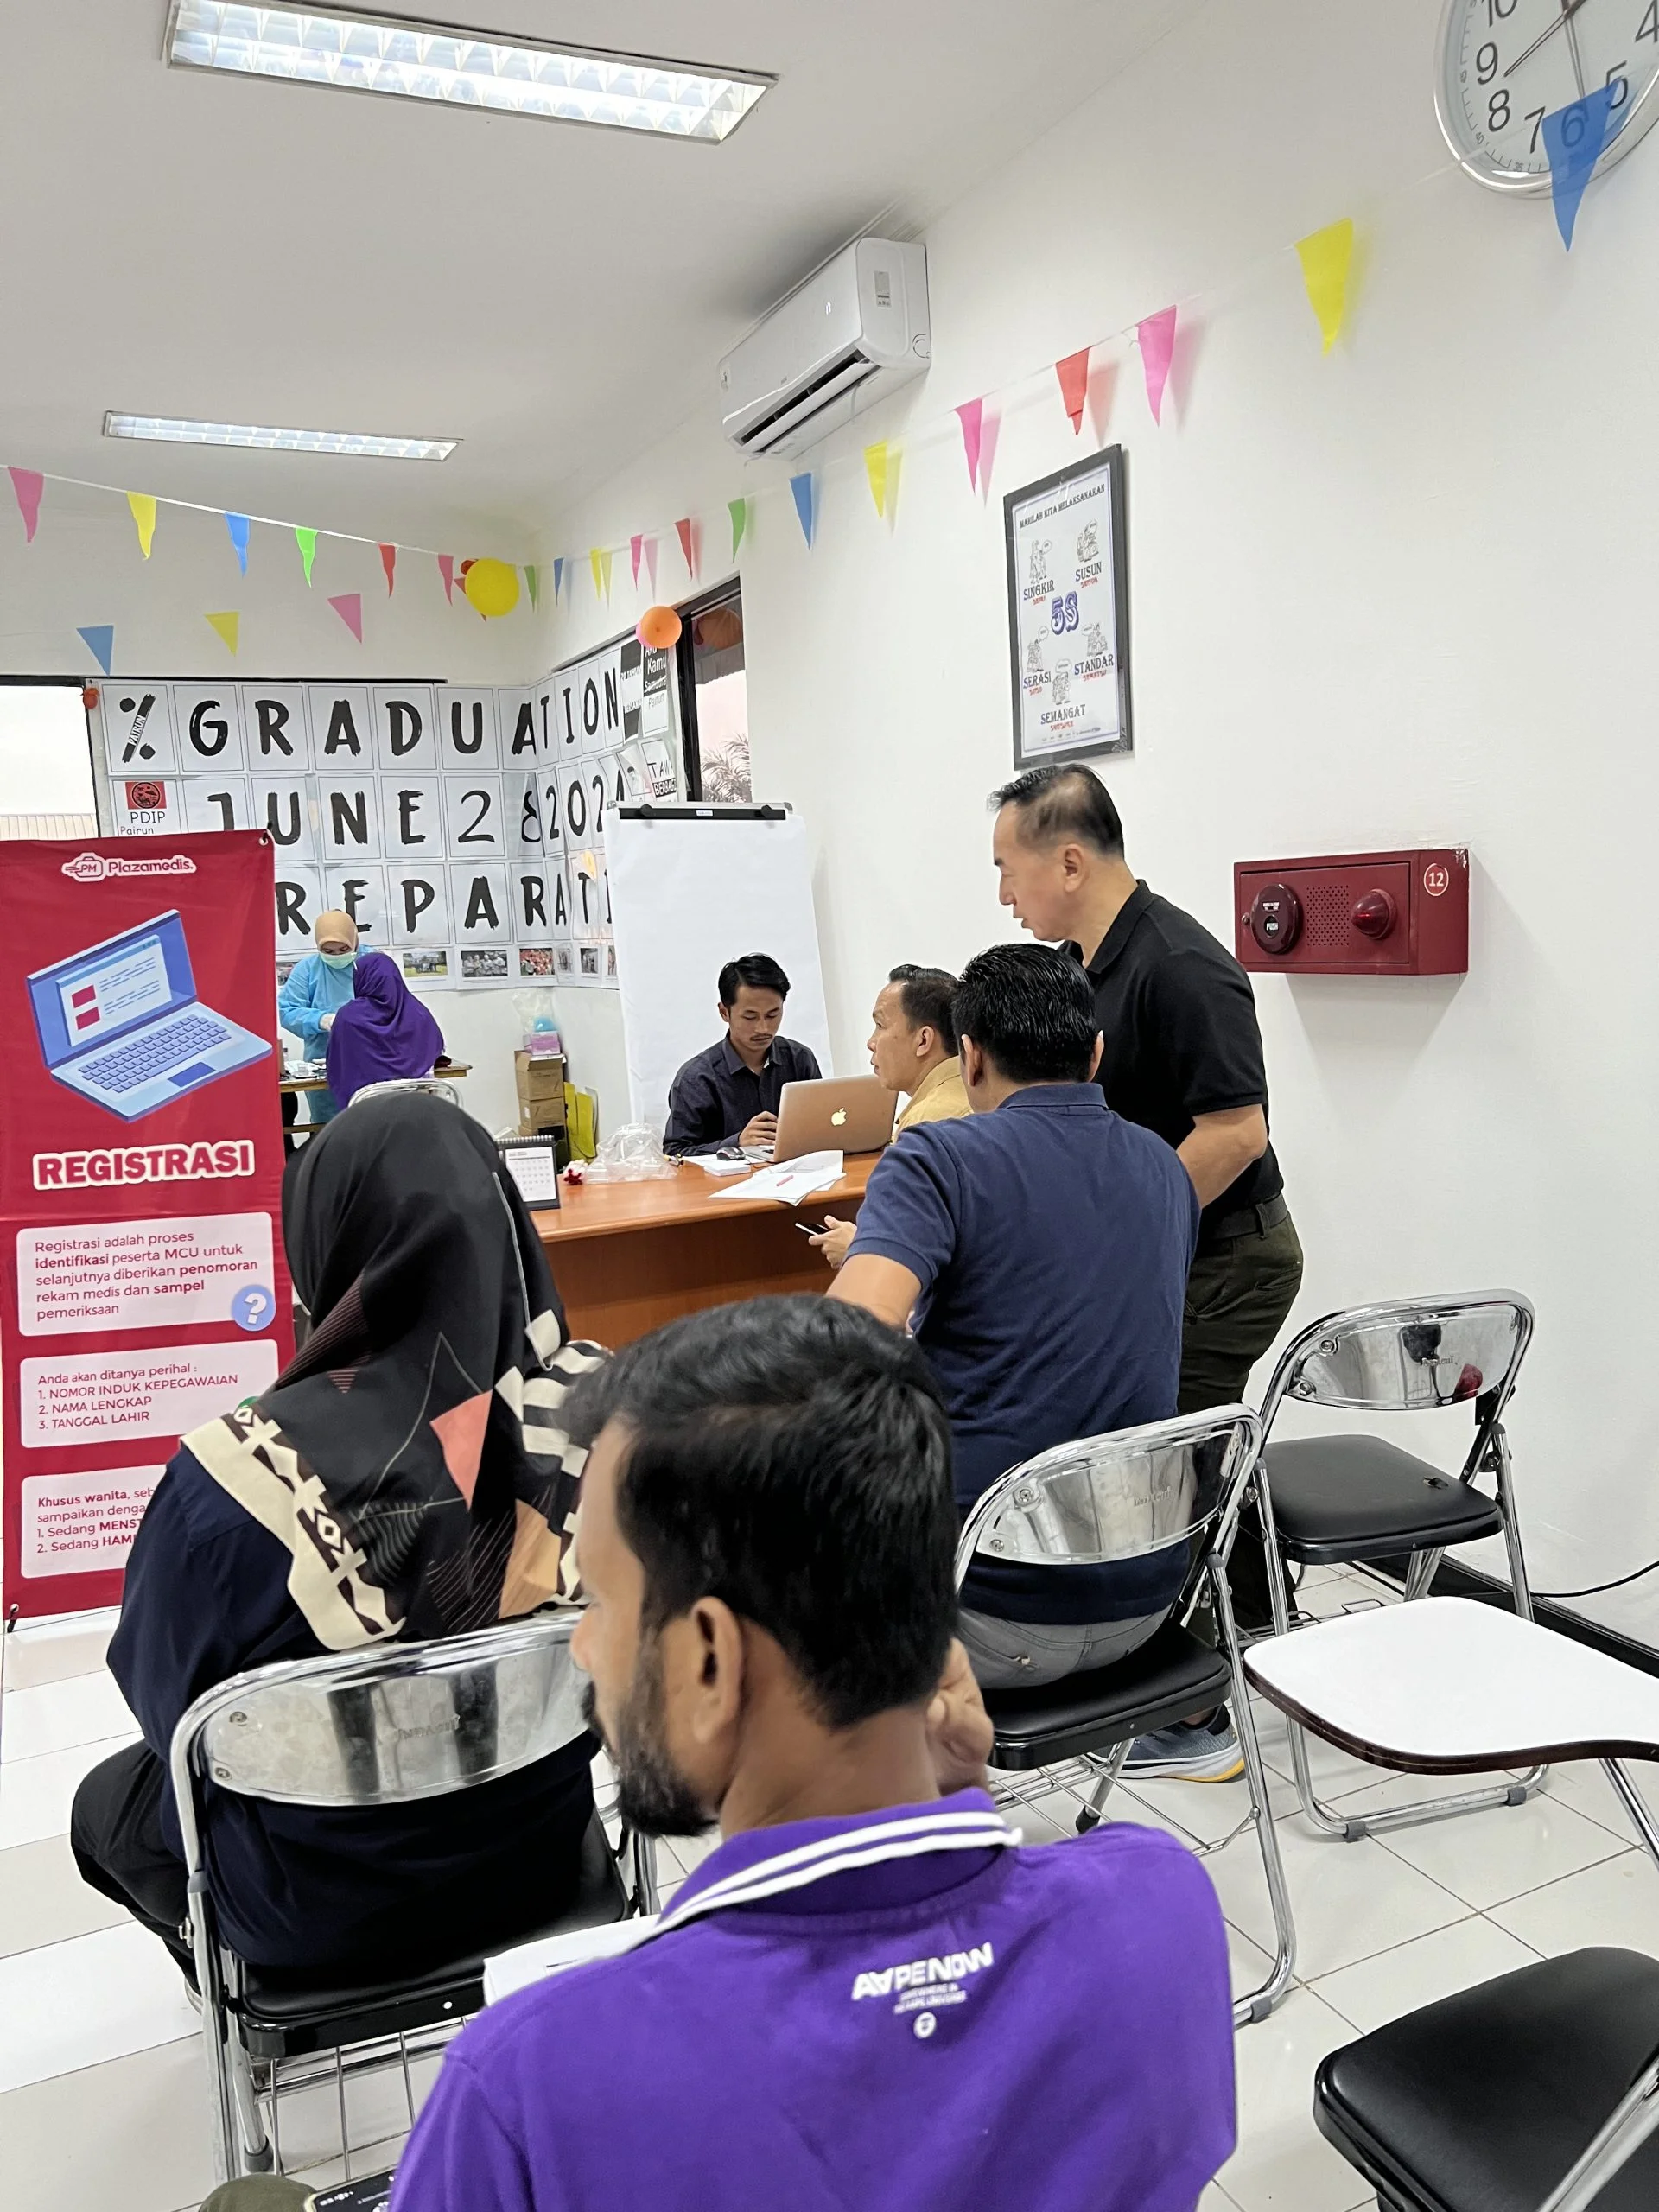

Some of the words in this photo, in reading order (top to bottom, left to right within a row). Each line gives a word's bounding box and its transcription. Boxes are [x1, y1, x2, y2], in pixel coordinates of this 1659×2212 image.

[1476, 41, 1498, 85] 9
[1605, 60, 1629, 110] 5
[1488, 89, 1510, 132] 8
[1524, 106, 1546, 154] 7
[1560, 102, 1589, 148] 6
[1044, 505, 1058, 518] KITA
[1058, 484, 1105, 512] MELAKSANAKAN
[1075, 562, 1103, 582] SUSUN
[1023, 580, 1055, 601] SINGKIR
[1051, 591, 1079, 635] 5S
[1074, 654, 1114, 676] STANDAR
[1023, 671, 1052, 690] SERASI
[189, 667, 620, 756] GRADUATION
[1040, 704, 1086, 725] SEMANGAT
[128, 715, 146, 746] PAIRUN
[130, 810, 166, 824] PDIP
[207, 790, 426, 845] JUNE
[458, 790, 542, 843] 28
[120, 825, 154, 836] Pairun
[81, 863, 97, 873] PM
[1428, 872, 1444, 887] 12
[38, 1144, 250, 1184] REGISTRASI
[35, 1237, 100, 1254] Registrasi
[105, 1234, 144, 1248] adalah
[149, 1233, 194, 1246] proses
[35, 1254, 109, 1268] identifikasi
[112, 1250, 160, 1266] peserta
[165, 1247, 199, 1260] MCU
[203, 1244, 243, 1257] untuk
[36, 1272, 110, 1287] selanjutnya
[113, 1267, 175, 1280] diberikan
[180, 1262, 258, 1277] penomoran
[36, 1291, 79, 1303] rekam
[83, 1286, 120, 1299] medis
[124, 1285, 149, 1296] dan
[154, 1280, 205, 1294] sampel
[37, 1305, 119, 1322] pemeriksaan
[38, 1373, 68, 1385] Anda
[72, 1372, 97, 1382] akan
[100, 1370, 145, 1380] ditanya
[149, 1363, 190, 1378] perihal
[38, 1389, 47, 1400] 1.
[49, 1386, 96, 1399] NOMOR
[99, 1382, 141, 1395] INDUK
[144, 1374, 238, 1391] KEPEGAWAIAN
[38, 1405, 48, 1414] 2.
[52, 1402, 87, 1414] NAMA
[91, 1395, 152, 1411] LENGKAP
[39, 1420, 49, 1430] 3.
[52, 1415, 108, 1428] TANGGAL
[111, 1411, 149, 1424] LAHIR
[38, 1497, 81, 1507] Khusus
[85, 1491, 130, 1503] wanita,
[38, 1509, 104, 1522] sampaikan
[107, 1505, 146, 1516] denga
[37, 1529, 44, 1538] 1.
[48, 1525, 95, 1537] Sedang
[37, 1544, 48, 1553] 2.
[51, 1539, 99, 1552] Sedang
